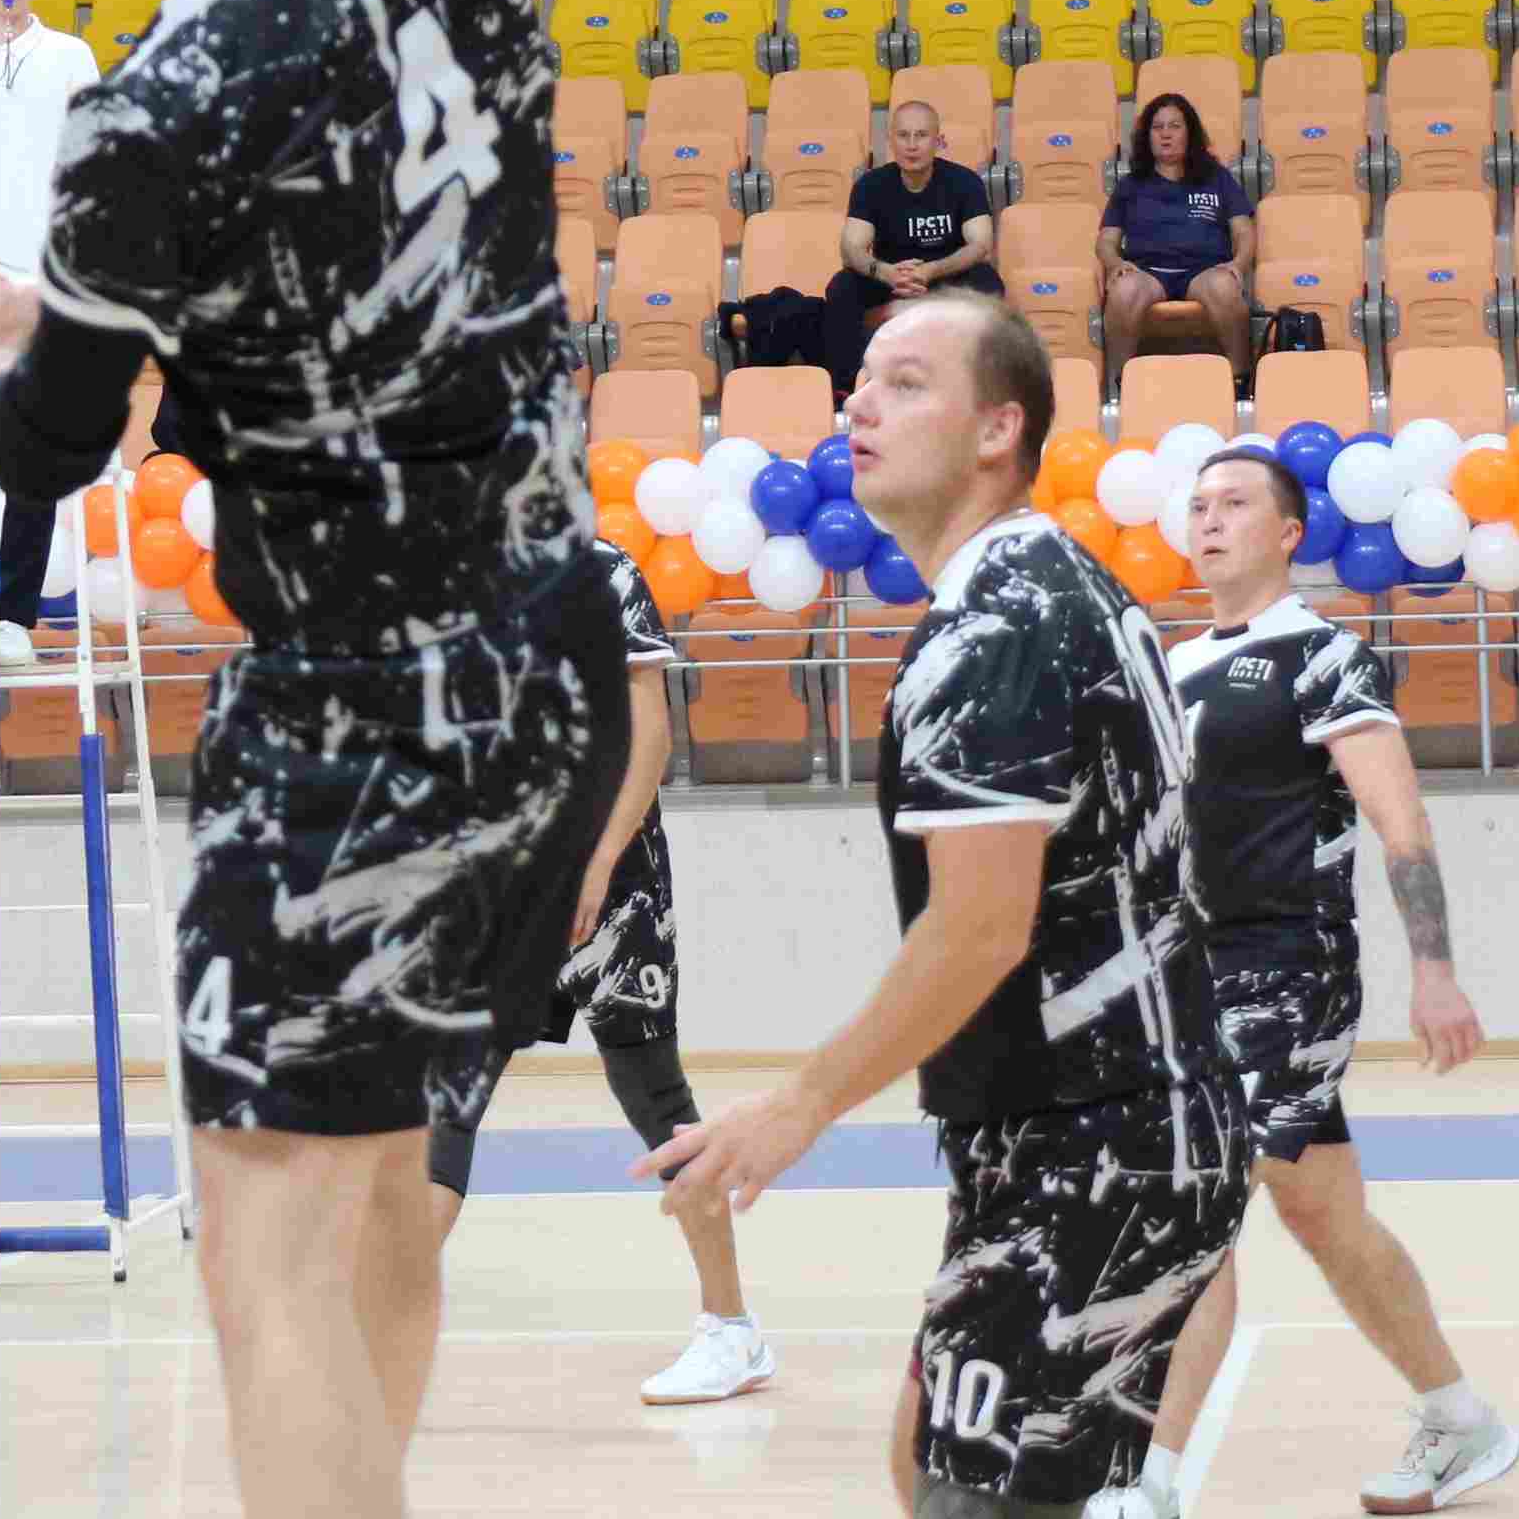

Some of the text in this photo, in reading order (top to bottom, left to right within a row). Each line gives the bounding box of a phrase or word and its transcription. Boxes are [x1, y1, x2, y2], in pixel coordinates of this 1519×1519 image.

[185, 955, 233, 1057] 4
[639, 963, 666, 1009] 9
[930, 1349, 1004, 1438] 10
